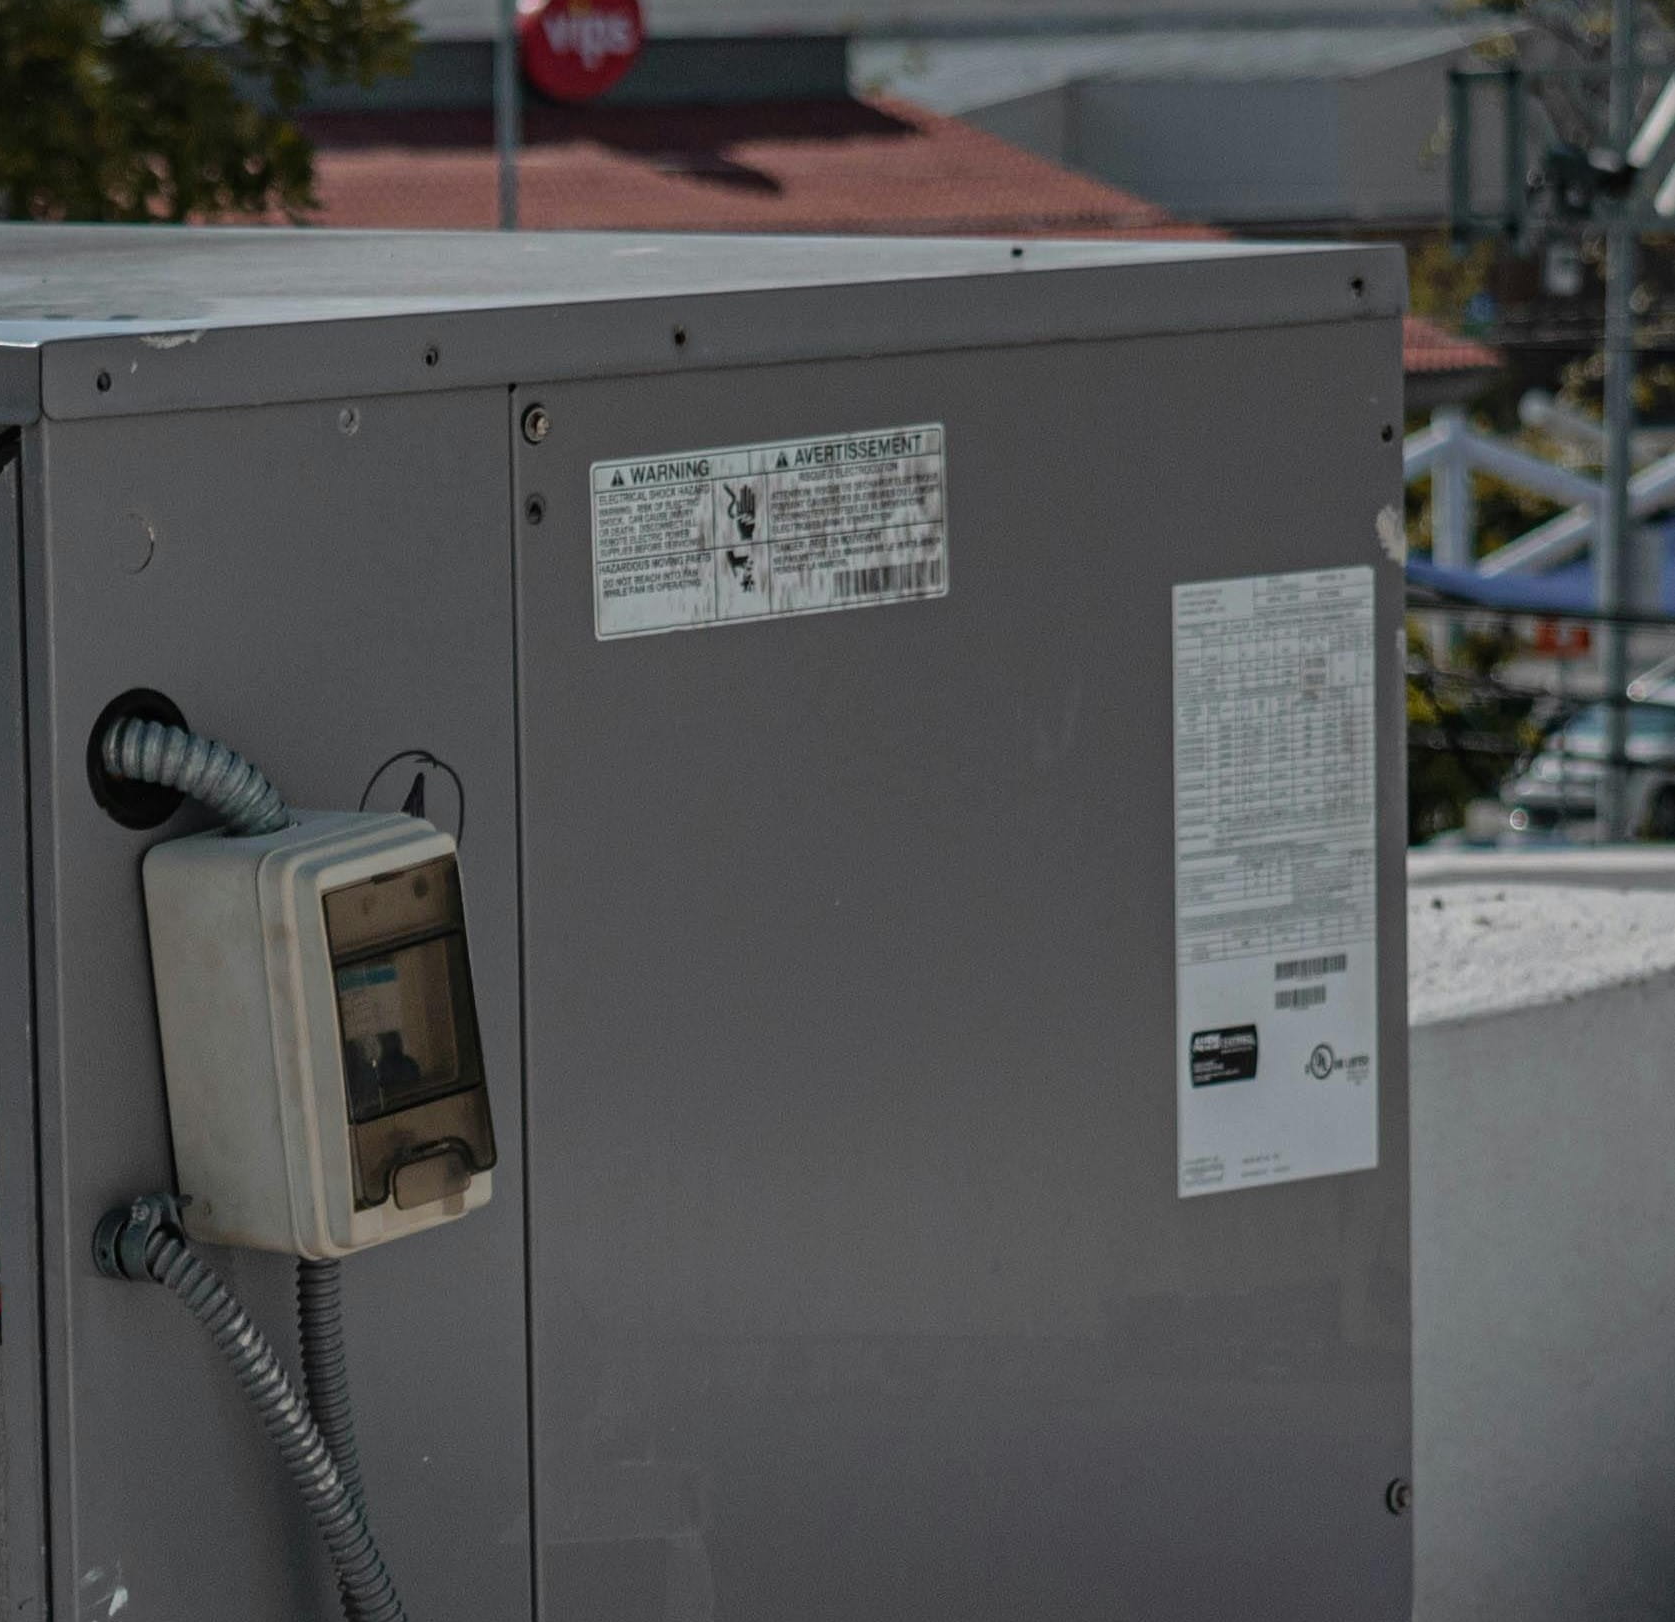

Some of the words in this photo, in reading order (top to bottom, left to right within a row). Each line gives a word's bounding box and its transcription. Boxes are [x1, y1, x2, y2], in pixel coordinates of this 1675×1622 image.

[794, 434, 922, 466] AVERTISSEMENT
[631, 459, 709, 484] WARNING
[599, 492, 647, 506] ELECTRICAL
[649, 487, 676, 500] SHOCK
[678, 484, 710, 496] HAZARD
[599, 559, 650, 574] HAZARDOUS
[651, 556, 683, 568] MOVING
[686, 552, 711, 563] PARTS
[603, 578, 614, 588] DO
[616, 577, 632, 586] NOT
[663, 570, 681, 580] INTO
